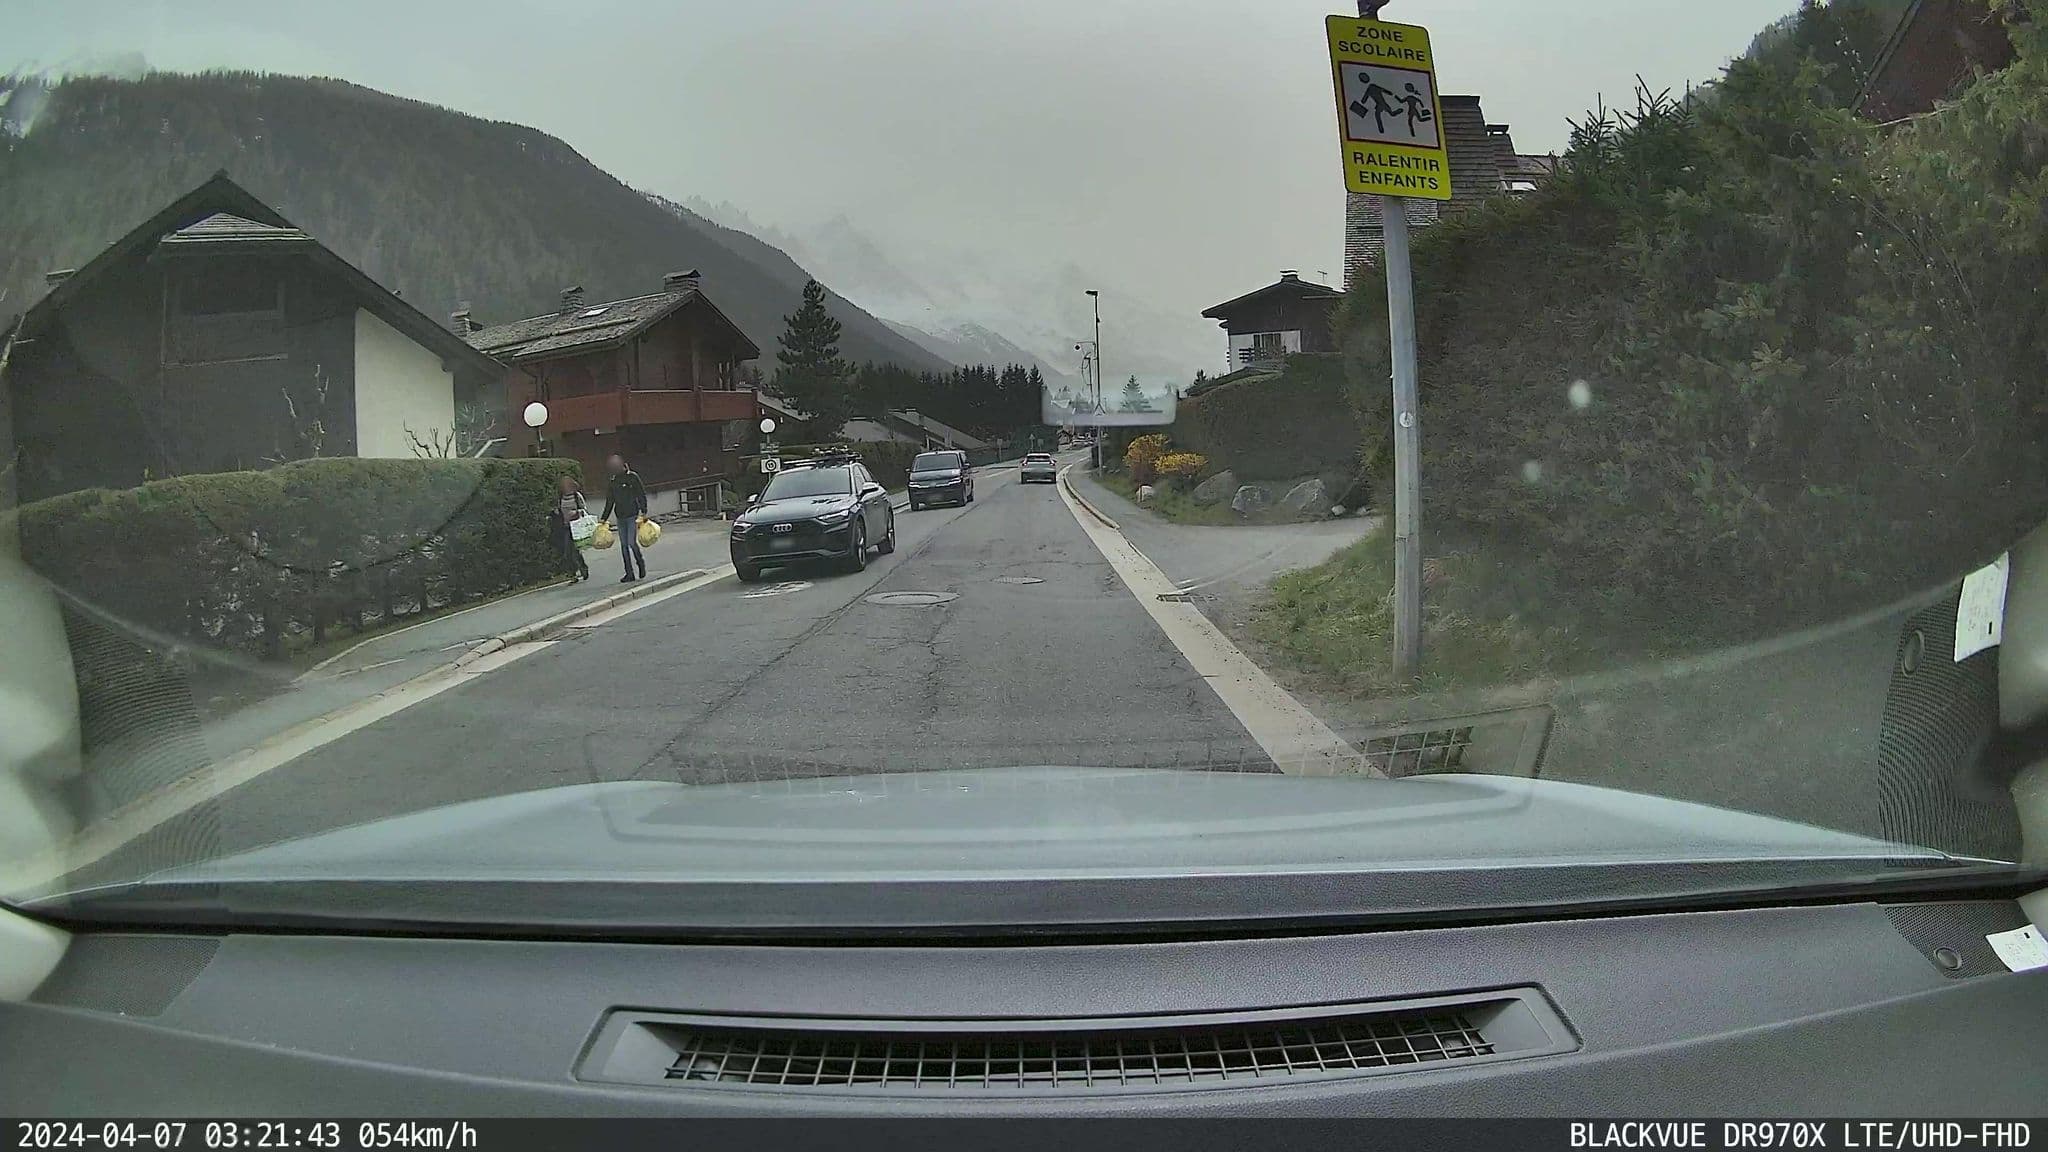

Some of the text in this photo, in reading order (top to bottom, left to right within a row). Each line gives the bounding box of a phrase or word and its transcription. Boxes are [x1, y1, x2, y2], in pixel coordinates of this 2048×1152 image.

[1357, 26, 1404, 42] ZONE
[1338, 40, 1426, 62] SCOLAIRE
[1353, 151, 1440, 172] RALENTIR
[1359, 170, 1438, 190] ENFANTS
